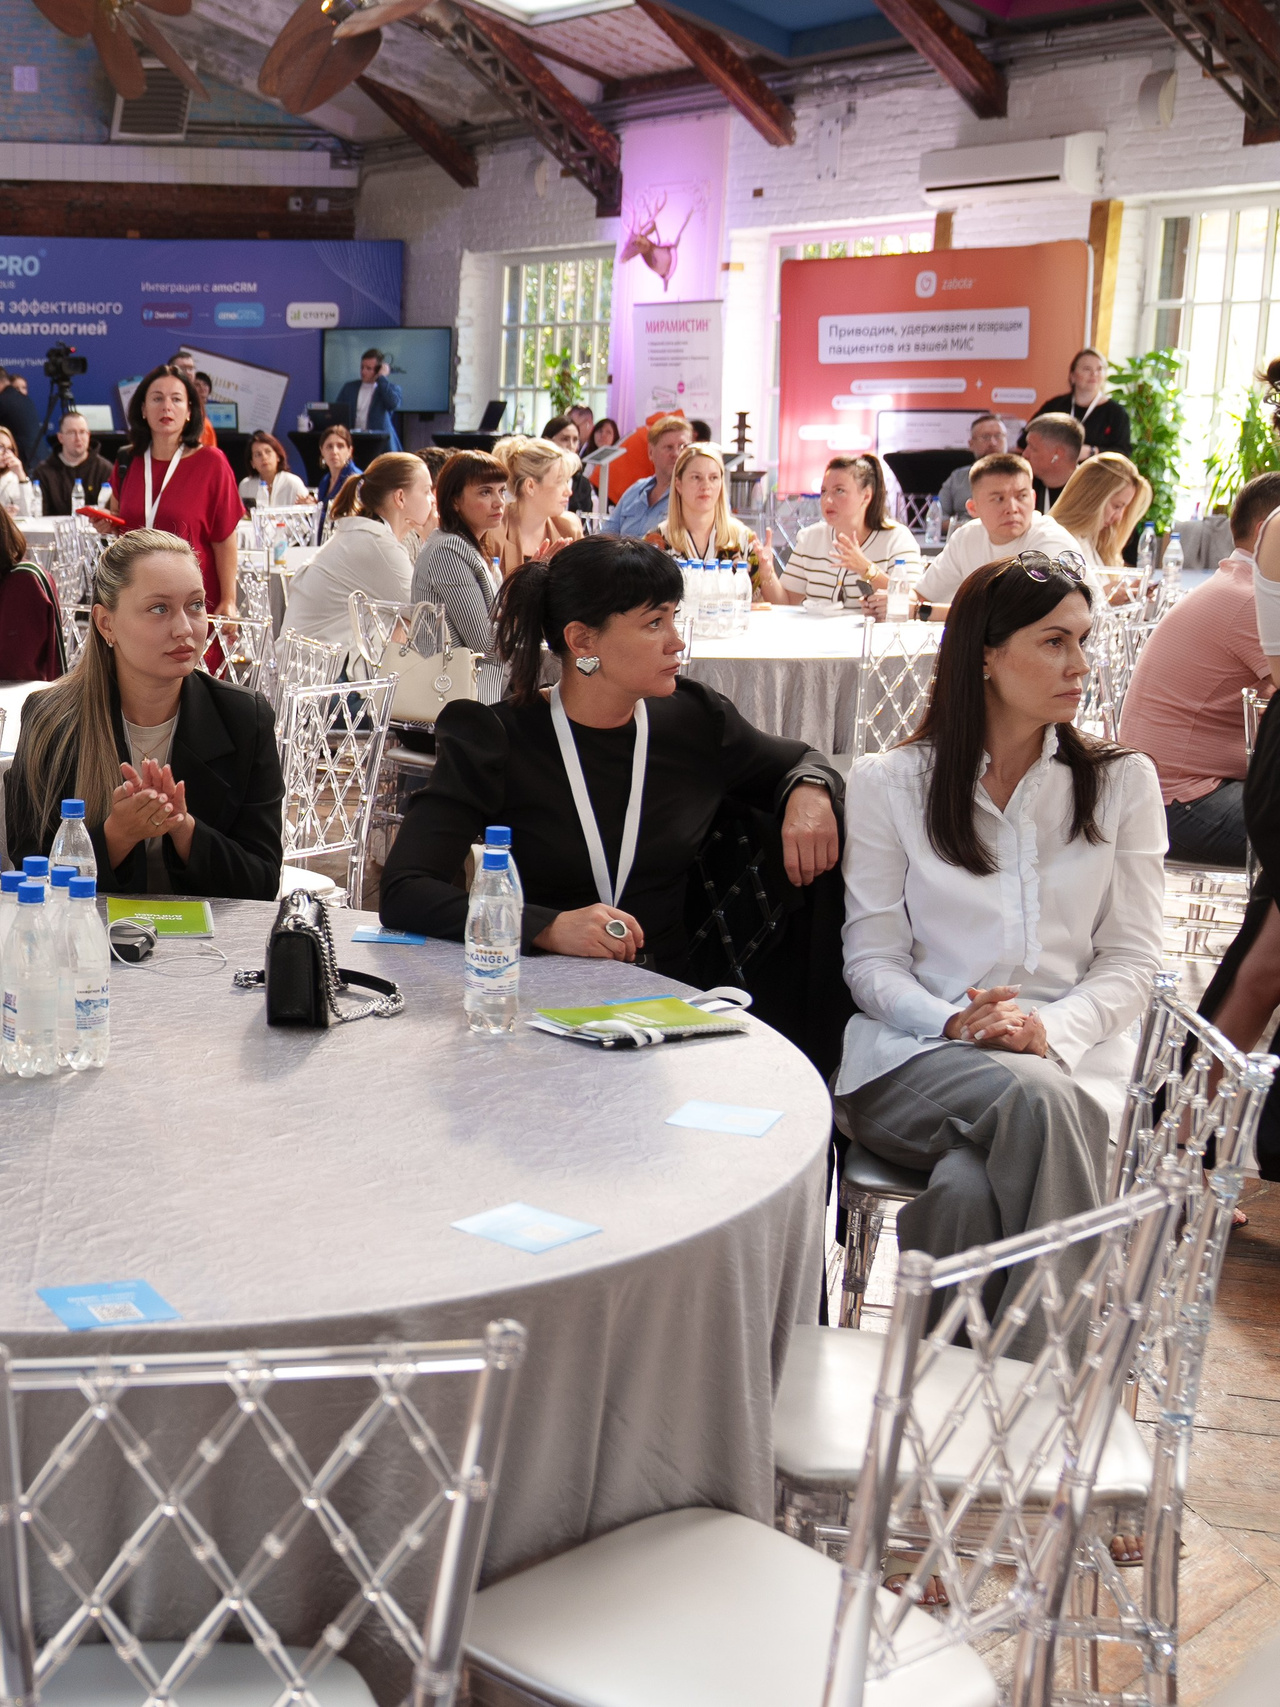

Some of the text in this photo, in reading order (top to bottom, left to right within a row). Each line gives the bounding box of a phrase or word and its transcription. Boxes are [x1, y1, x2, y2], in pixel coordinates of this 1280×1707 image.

[141, 281, 201, 294] Интеграция
[211, 282, 257, 293] amoCRM
[8, 299, 123, 317] эффективного
[645, 319, 709, 333] МИРАМИСТИН
[829, 324, 897, 340] Приводим,
[900, 323, 967, 338] удерживаем
[828, 344, 894, 356] пациентов
[897, 343, 911, 353] из
[950, 337, 974, 351] МИС
[470, 952, 509, 964] KANGEN
